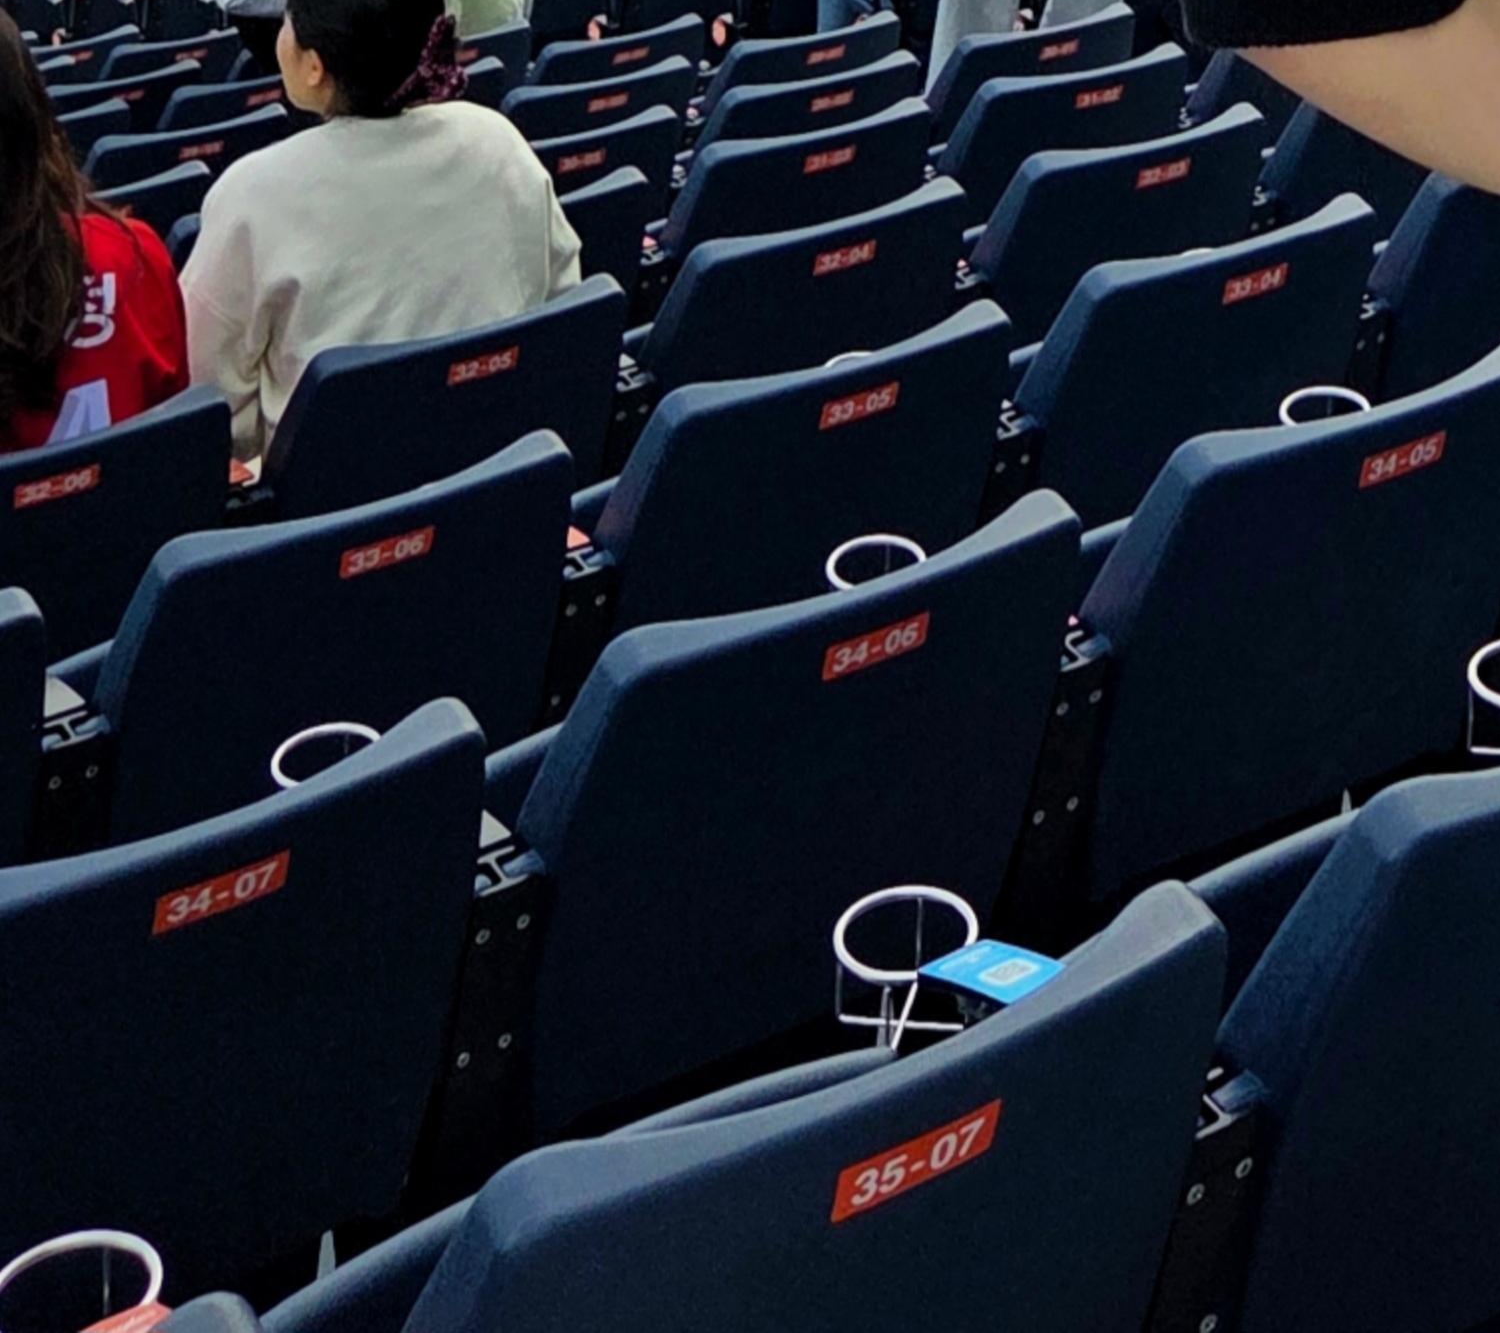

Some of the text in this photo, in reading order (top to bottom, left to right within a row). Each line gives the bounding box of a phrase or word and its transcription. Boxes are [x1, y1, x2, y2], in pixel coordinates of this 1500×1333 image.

[1231, 268, 1280, 299] 33-04
[453, 351, 511, 381] 32-05
[830, 390, 891, 424] 33-05
[1368, 439, 1436, 483] 34-05
[349, 534, 424, 572] 33-06
[833, 622, 918, 673] 34-06
[166, 860, 278, 923] 34-07
[851, 1117, 985, 1208] 35-07
